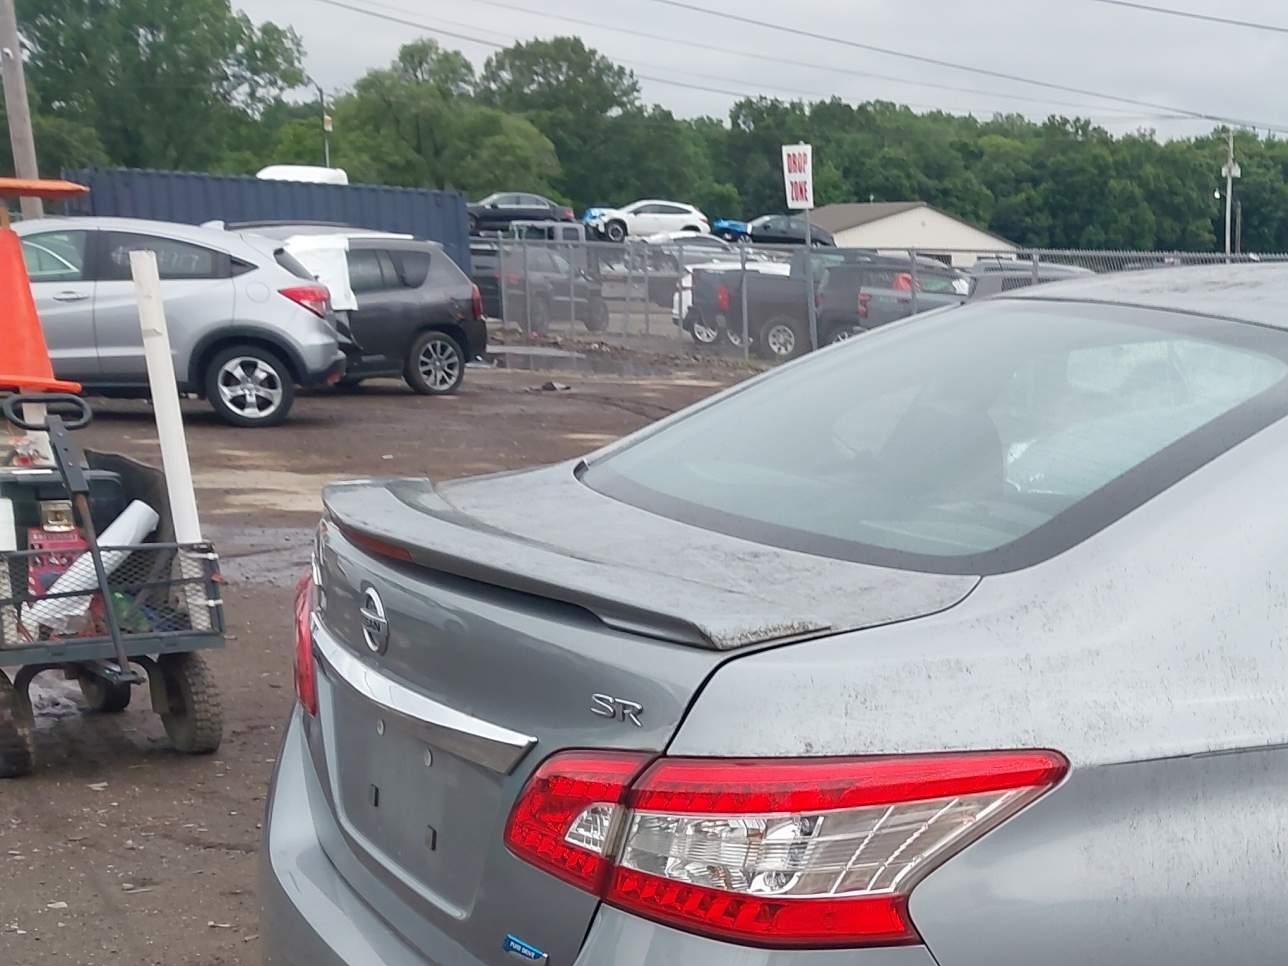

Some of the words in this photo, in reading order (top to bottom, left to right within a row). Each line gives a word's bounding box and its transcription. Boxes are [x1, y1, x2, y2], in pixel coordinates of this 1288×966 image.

[787, 152, 808, 174] DROP
[790, 180, 809, 202] ZONE
[590, 693, 642, 726] SR
